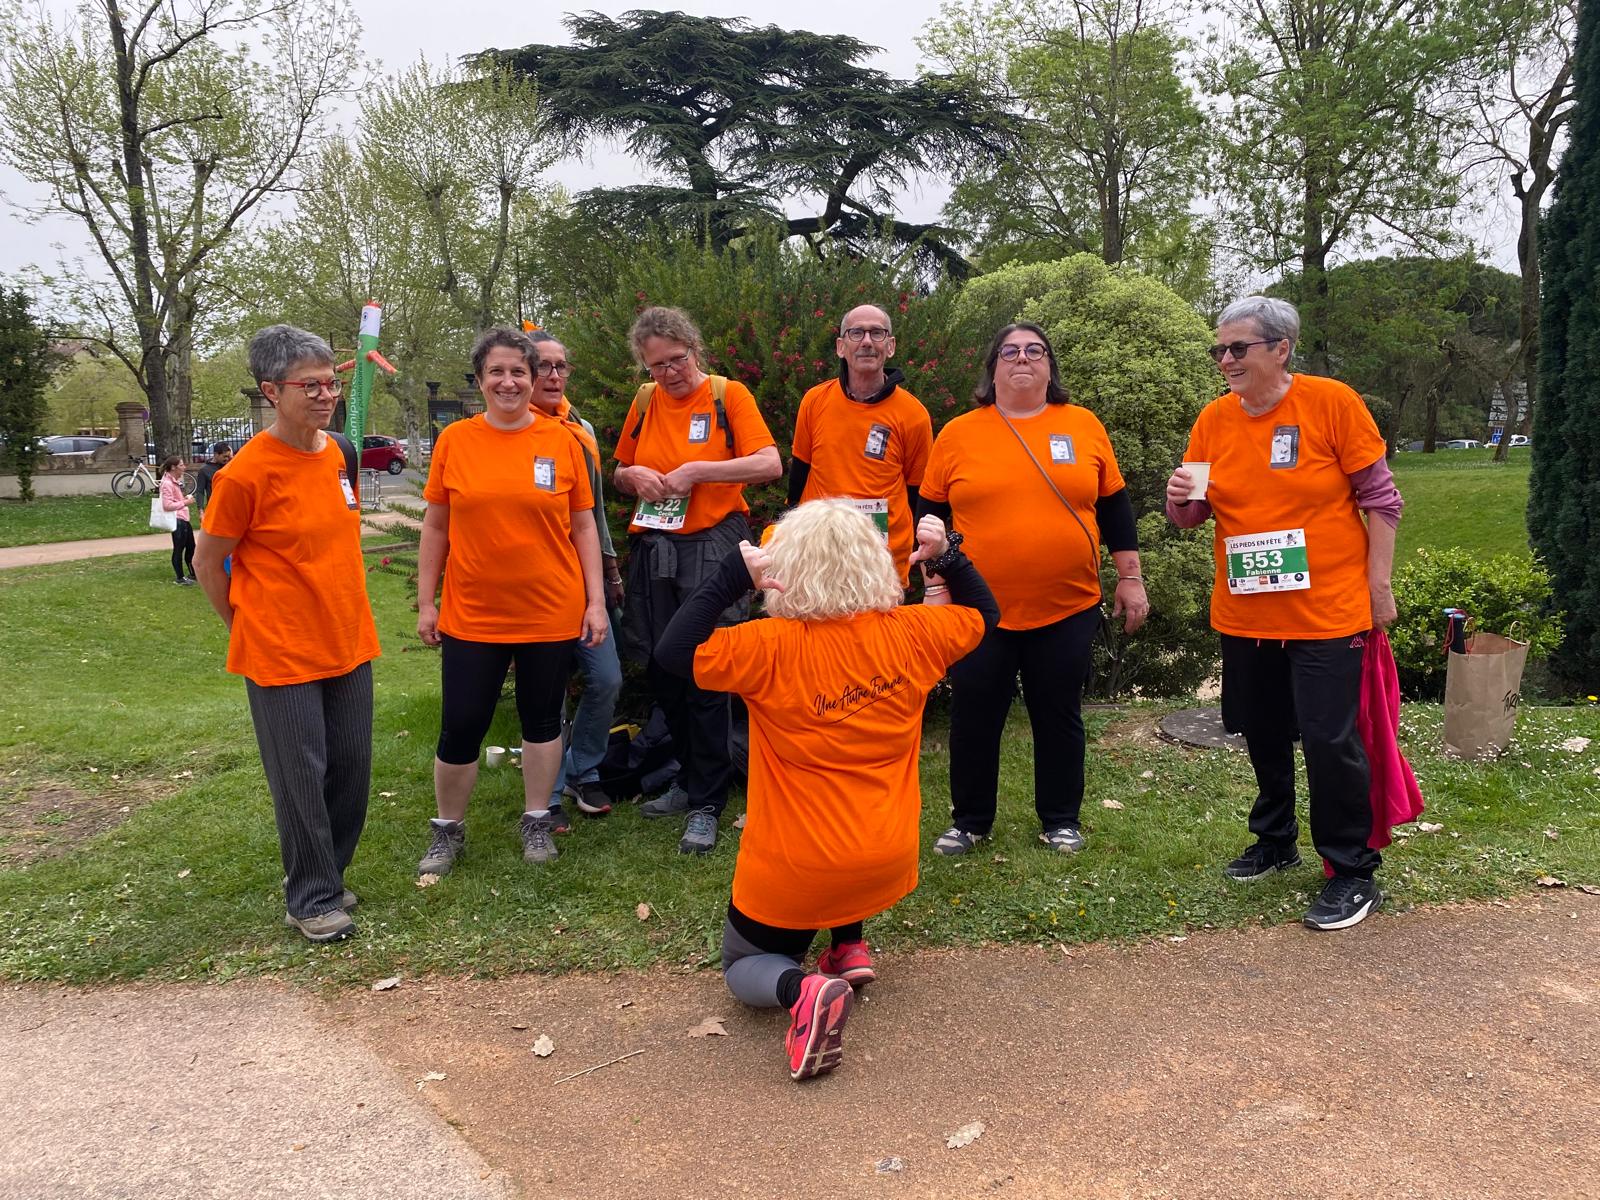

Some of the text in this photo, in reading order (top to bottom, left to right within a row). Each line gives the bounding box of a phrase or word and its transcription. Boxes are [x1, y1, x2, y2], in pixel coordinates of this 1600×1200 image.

[654, 499, 681, 511] 522
[1242, 550, 1284, 569] 553
[1246, 568, 1281, 577] Fabienne
[814, 694, 838, 716] Une
[840, 684, 870, 711] Autre
[870, 675, 903, 699] Femme
